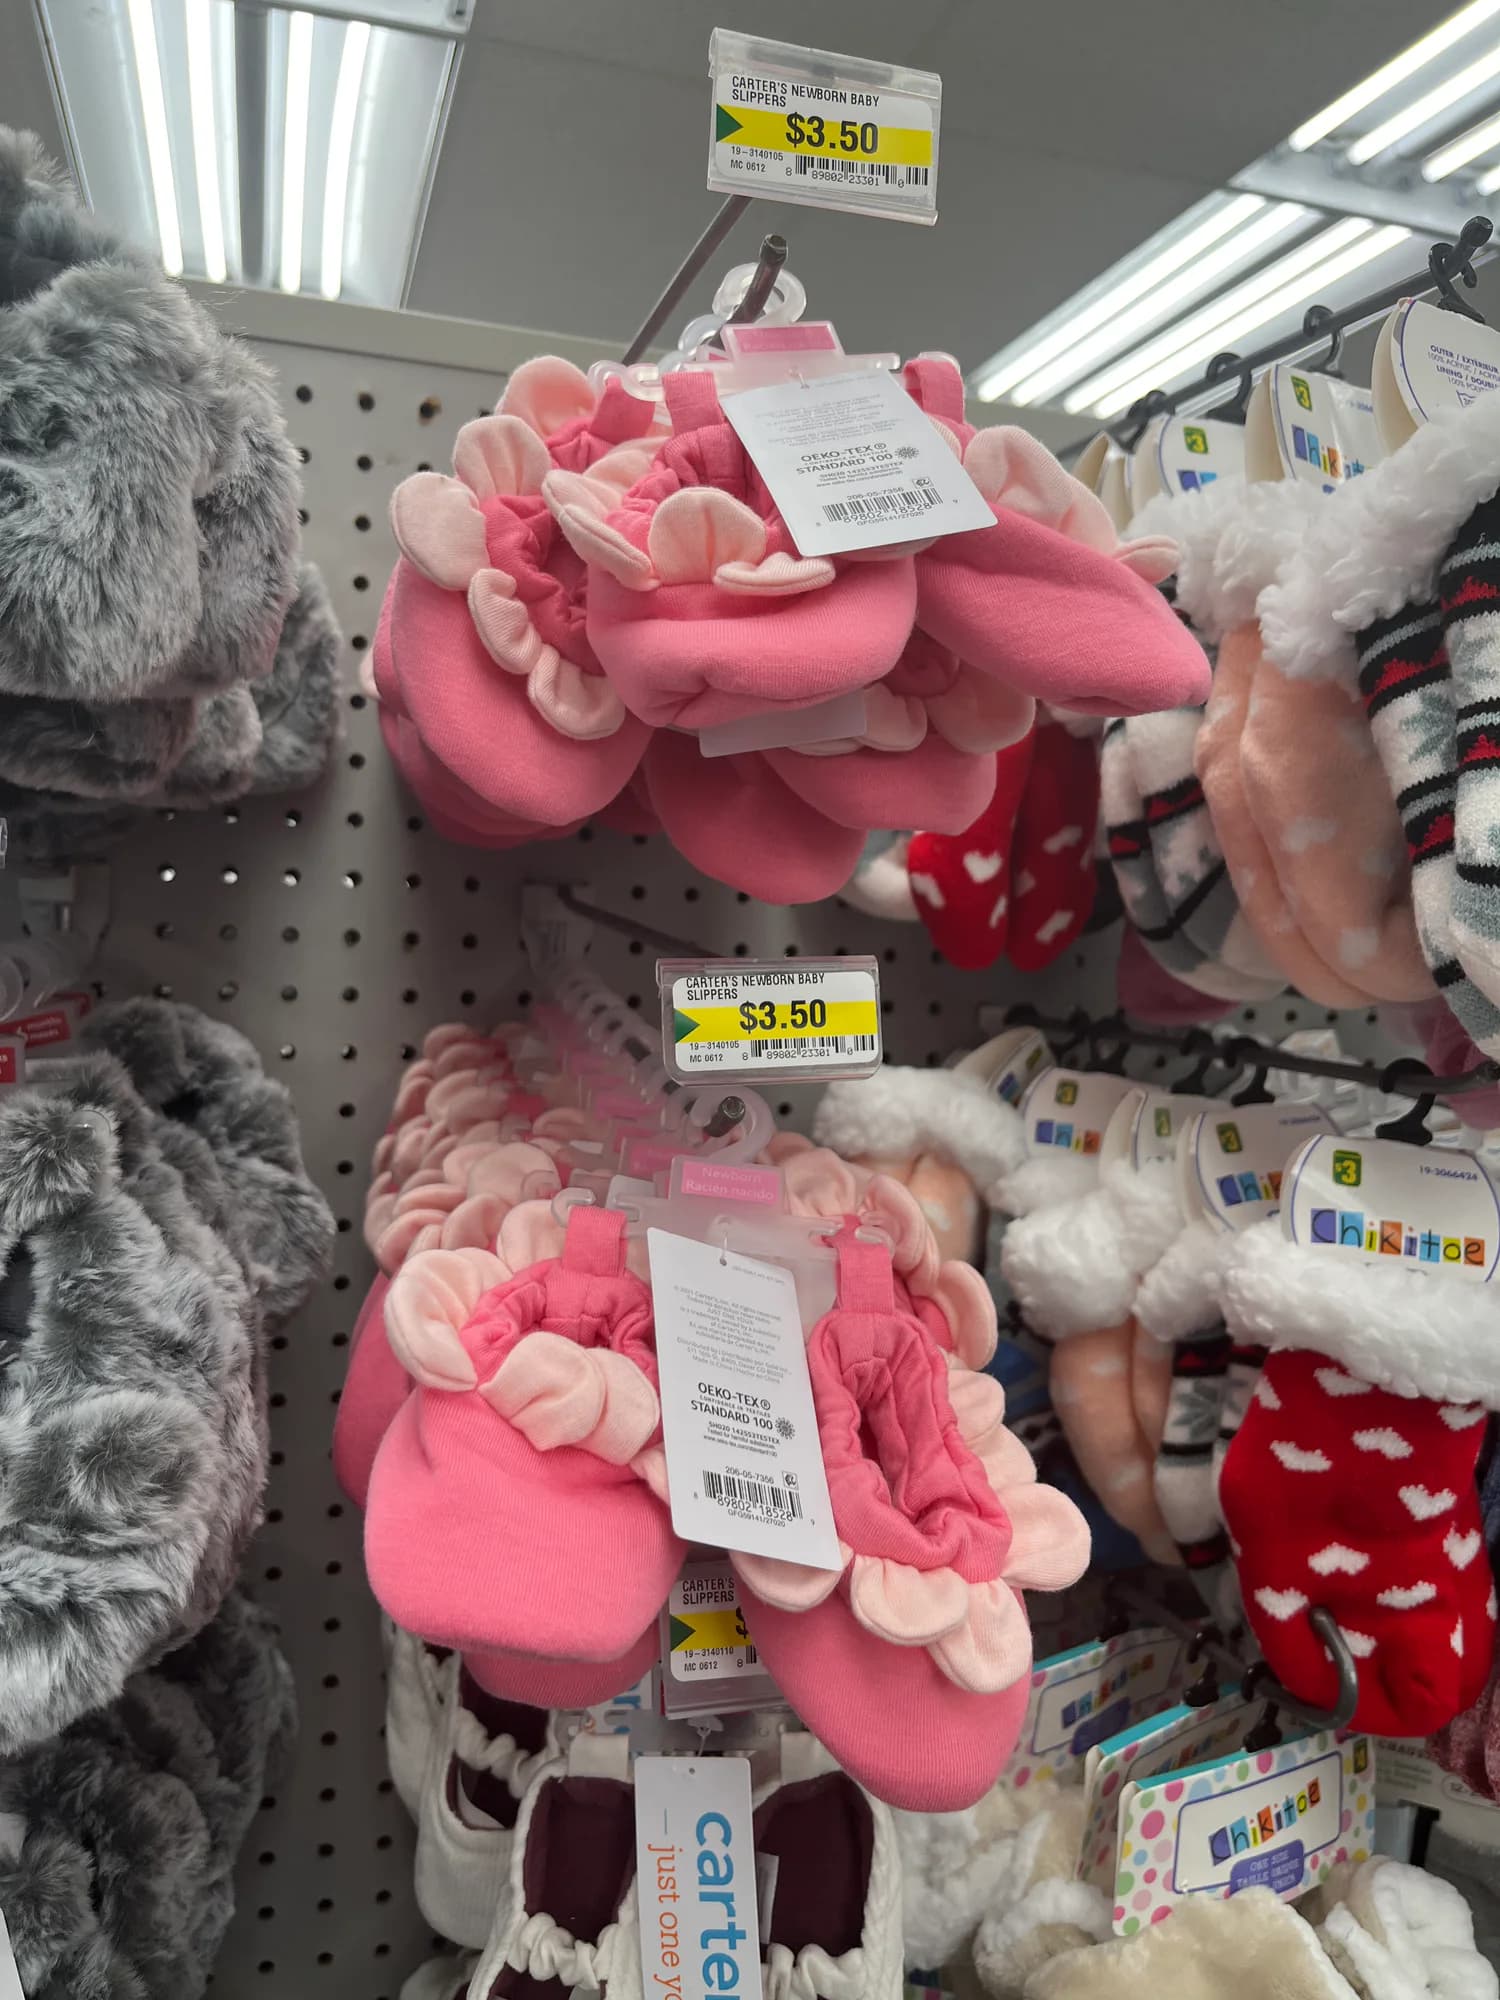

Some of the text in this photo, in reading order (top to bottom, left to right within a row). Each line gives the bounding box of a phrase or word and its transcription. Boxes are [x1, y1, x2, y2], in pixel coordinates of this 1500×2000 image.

[732, 75, 880, 107] CARTER'S NEWBORN BABY
[732, 89, 786, 107] SLIPPERS
[786, 111, 879, 154] $3.50
[730, 146, 784, 161] 19-3140105
[730, 160, 766, 173] MC 0612
[812, 169, 844, 183] 89802
[848, 174, 880, 187] 23301
[796, 458, 866, 475] STANDARD
[869, 453, 893, 463] 100
[843, 510, 884, 524] 89802
[892, 502, 933, 515] 18528
[686, 972, 825, 989] CARTER'S NEWBORN BABY
[687, 988, 738, 1001] SLIPPERS
[739, 999, 827, 1034] $3.50
[690, 1040, 740, 1050] 19-3140105
[766, 1050, 797, 1060] 89802
[801, 1048, 831, 1058] 23301
[690, 1053, 724, 1063] MC 0612
[690, 1399, 774, 1431] STANDARD 100
[725, 1465, 775, 1484] 206-05-7356
[717, 1494, 752, 1513] 89802
[759, 1504, 794, 1522] 18528
[682, 1577, 735, 1593] CARTER'S
[683, 1590, 735, 1606] SLIPPERS
[684, 1663, 697, 1672] MC
[699, 1661, 718, 1671] 0612
[647, 1843, 684, 1903] just
[659, 1911, 681, 1968] one
